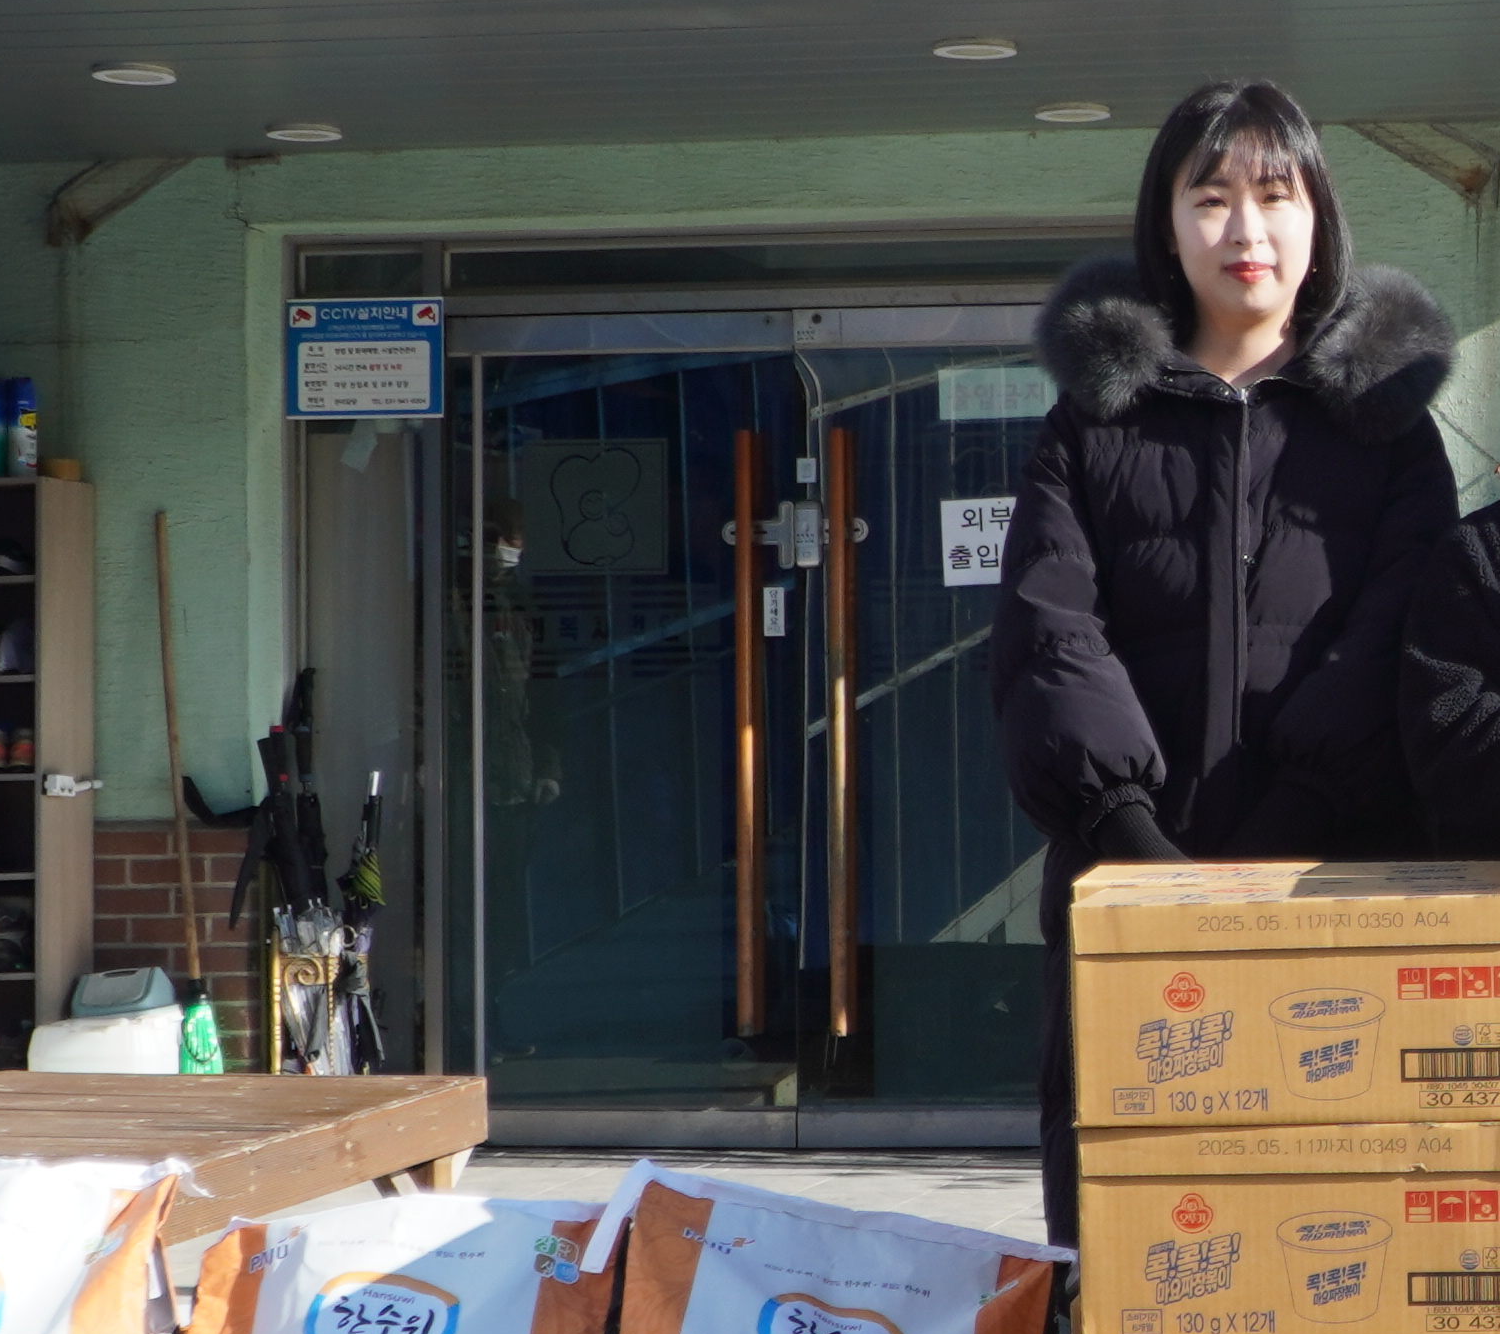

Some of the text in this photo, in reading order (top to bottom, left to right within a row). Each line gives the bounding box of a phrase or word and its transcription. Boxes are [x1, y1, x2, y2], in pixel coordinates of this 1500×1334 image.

[320, 307, 408, 320] CCTV설치안내
[1358, 912, 1404, 929] 0350
[1414, 911, 1451, 927] A04
[1168, 1092, 1197, 1112] 130
[1203, 1097, 1213, 1113] g
[1235, 1089, 1269, 1111] 12개
[1426, 1092, 1500, 1106] 30 437
